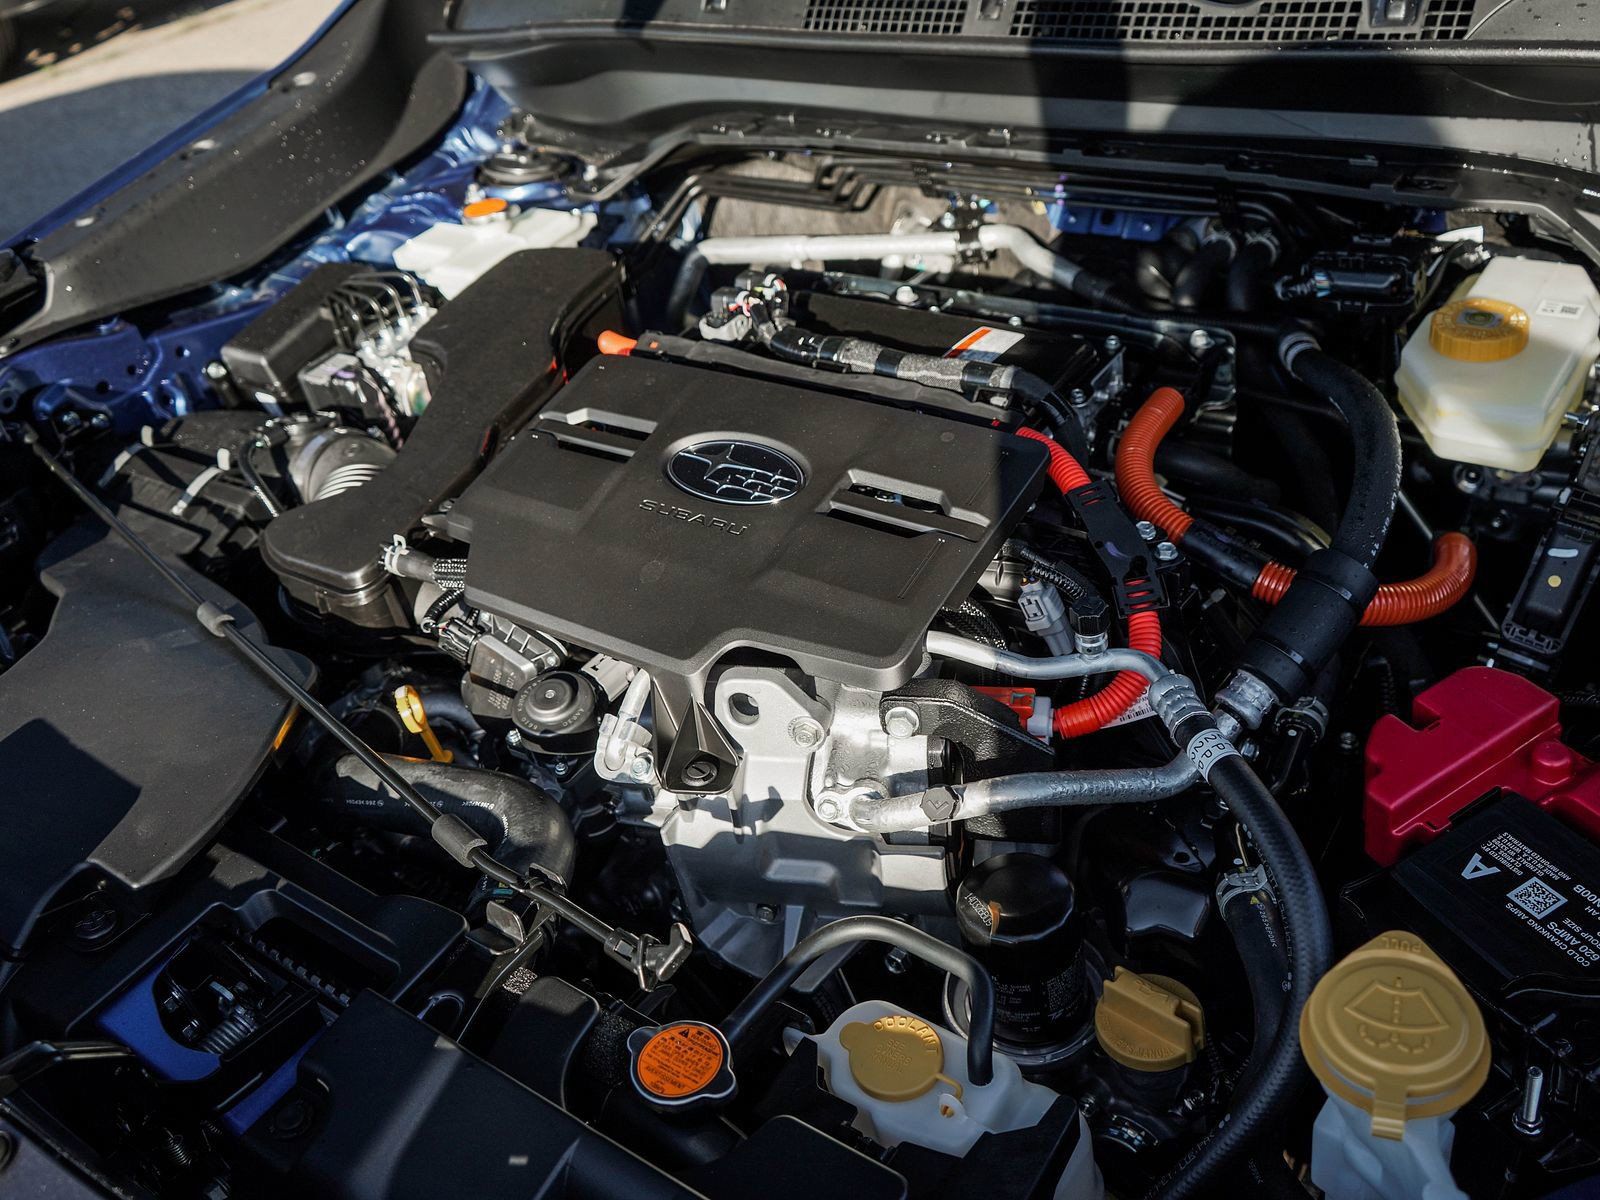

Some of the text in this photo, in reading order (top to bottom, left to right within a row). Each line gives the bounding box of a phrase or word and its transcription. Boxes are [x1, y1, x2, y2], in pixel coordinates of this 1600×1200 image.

[639, 499, 748, 535] SUBARU
[1502, 832, 1533, 854] MATERIALS
[1461, 852, 1501, 880] A
[1488, 850, 1523, 876] DISTRIBUTED
[1505, 903, 1590, 967] COLD CRANKING AMPS
[1562, 917, 1582, 933] SIZE
[1381, 937, 1421, 953] PULL
[1547, 921, 1600, 961] 620 AMPS
[873, 1015, 939, 1054] COOLANT
